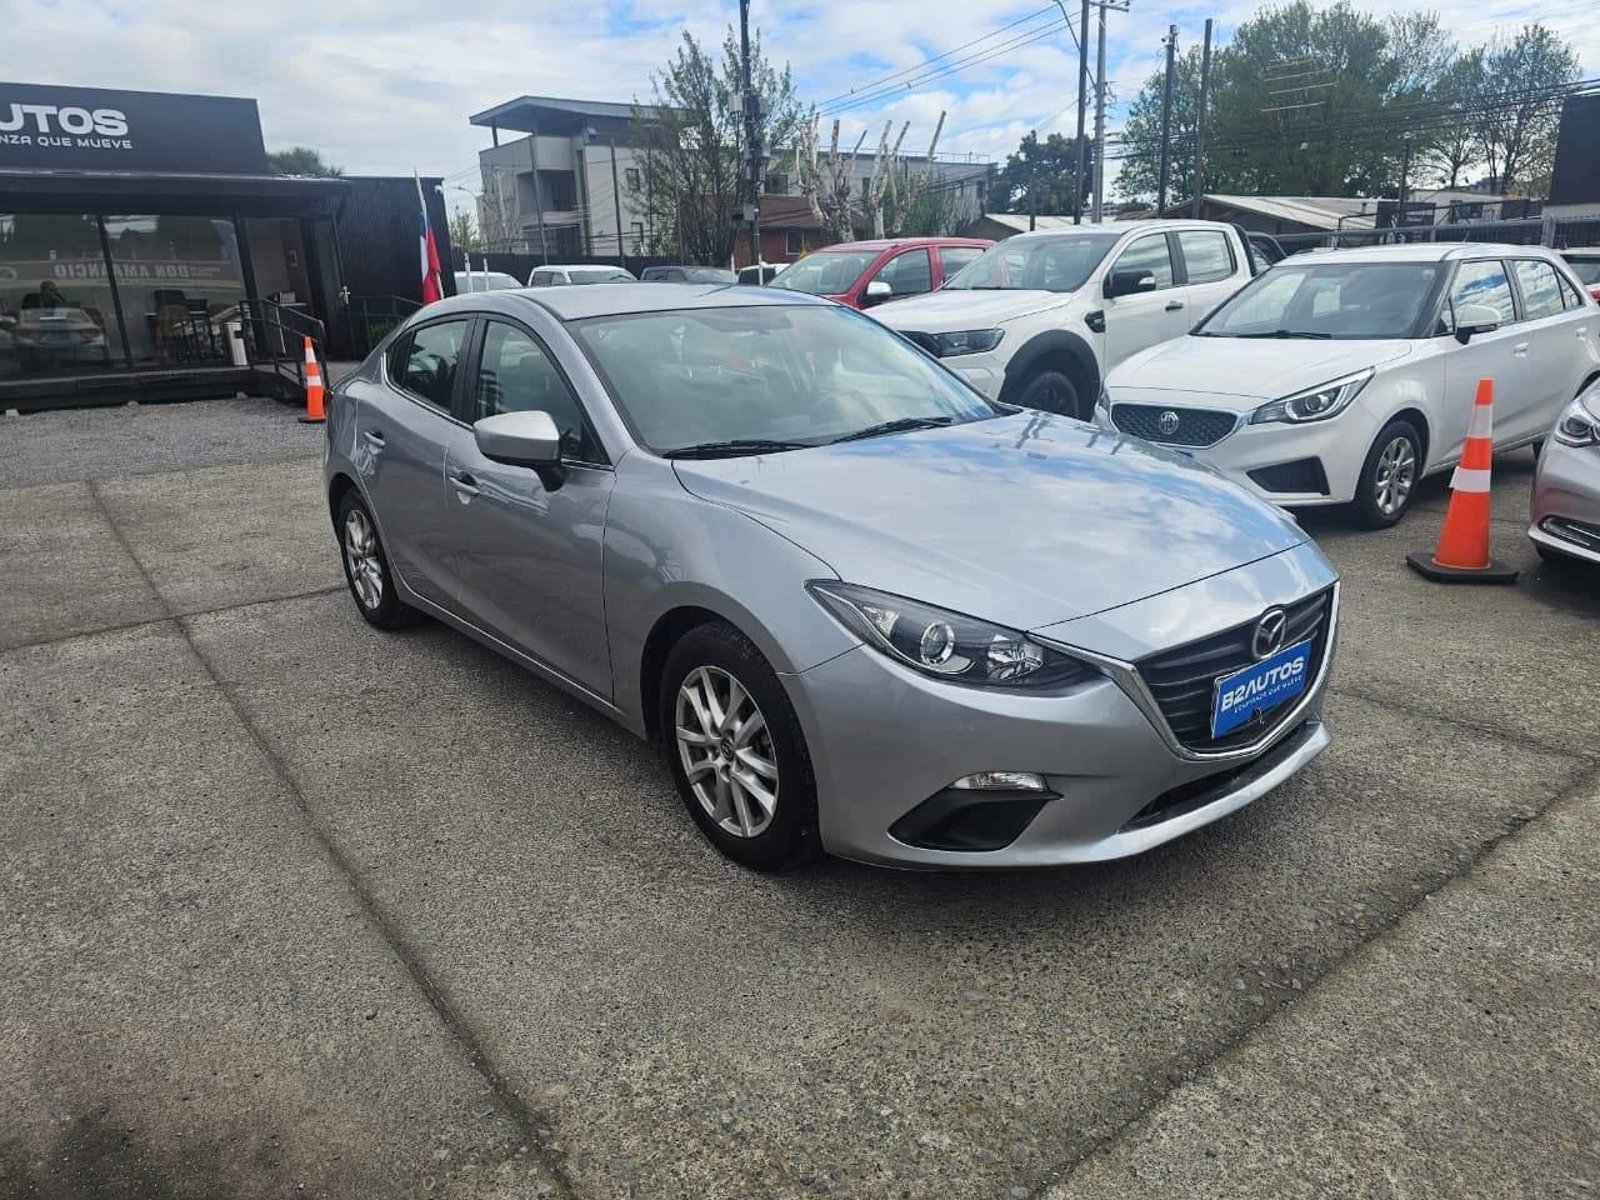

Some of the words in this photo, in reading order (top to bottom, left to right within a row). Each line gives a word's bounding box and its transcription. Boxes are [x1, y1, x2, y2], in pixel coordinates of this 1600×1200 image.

[38, 136, 72, 147] QUE
[77, 138, 133, 149] MUEVE
[1221, 656, 1304, 713] B2AUTOS
